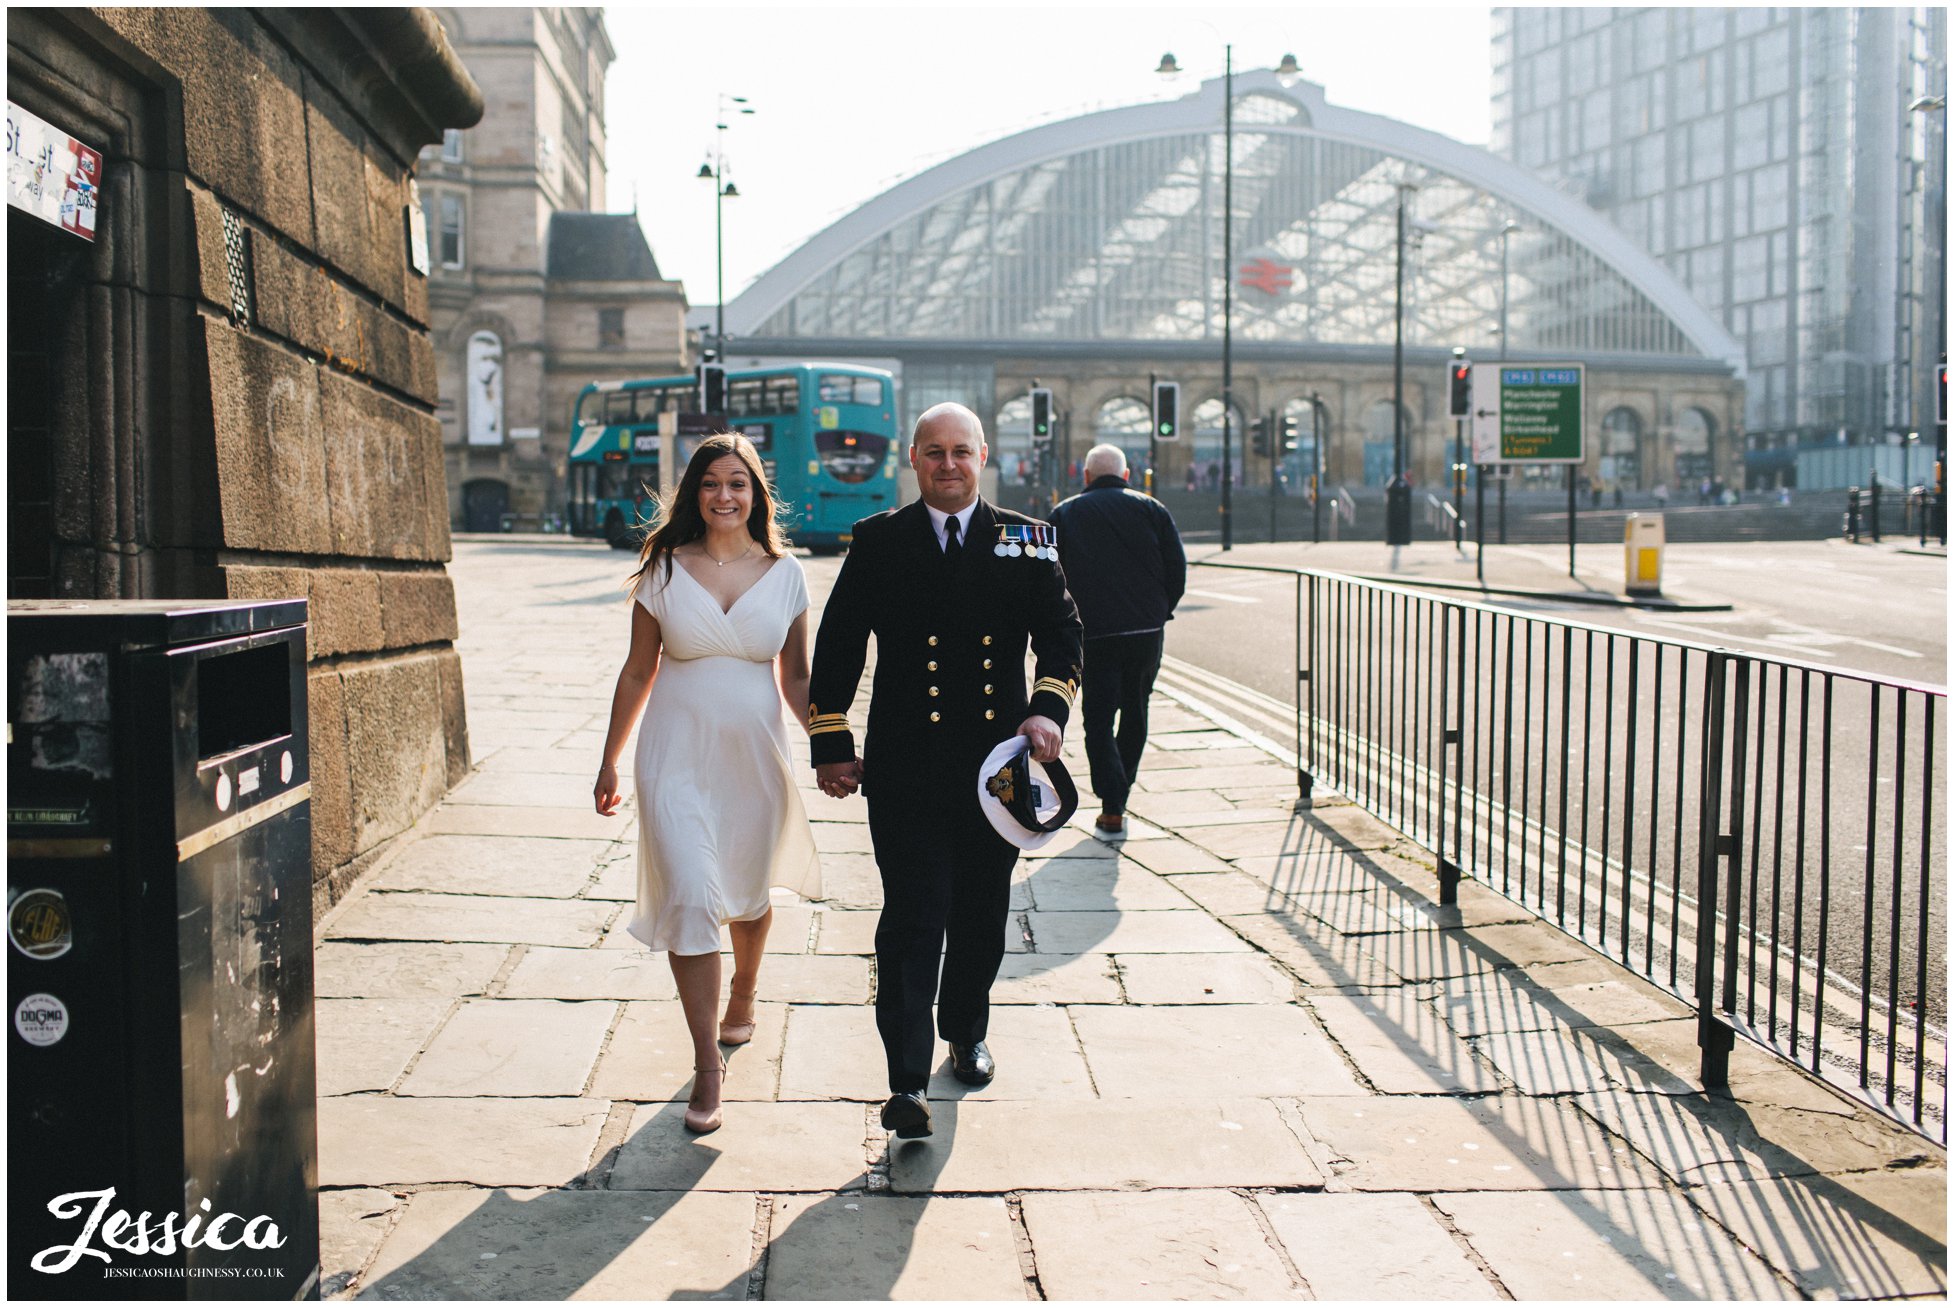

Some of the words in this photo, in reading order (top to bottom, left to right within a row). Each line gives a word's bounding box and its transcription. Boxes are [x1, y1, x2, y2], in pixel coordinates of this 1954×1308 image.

[1504, 390, 1561, 400] Manchester
[1504, 401, 1559, 412] Warrington
[21, 1008, 63, 1026] DOGMA
